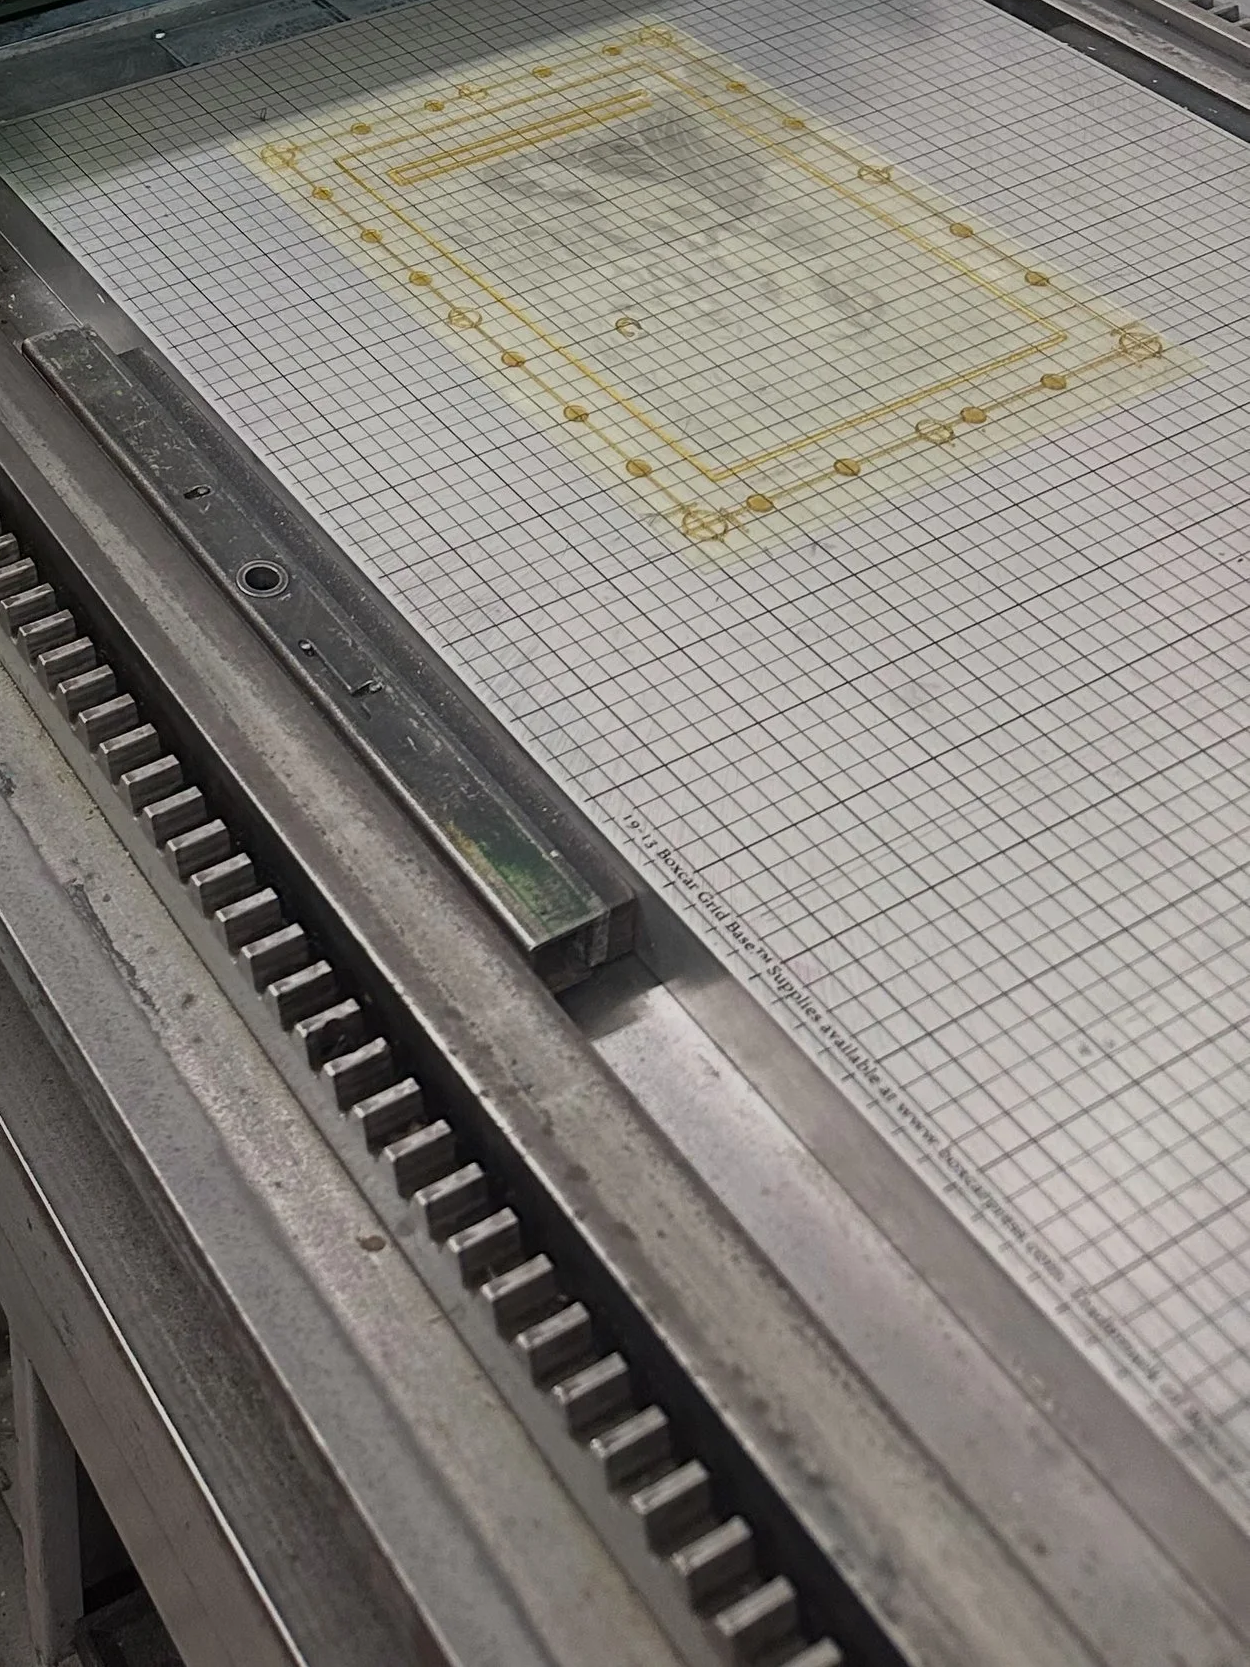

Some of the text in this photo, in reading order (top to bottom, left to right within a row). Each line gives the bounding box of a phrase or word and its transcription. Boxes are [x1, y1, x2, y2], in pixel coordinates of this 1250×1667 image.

[656, 846, 700, 891] Boxcar
[697, 890, 731, 922] Grid
[766, 963, 822, 1023] Supplies
[819, 1024, 882, 1085] available
[879, 1085, 898, 1102] at
